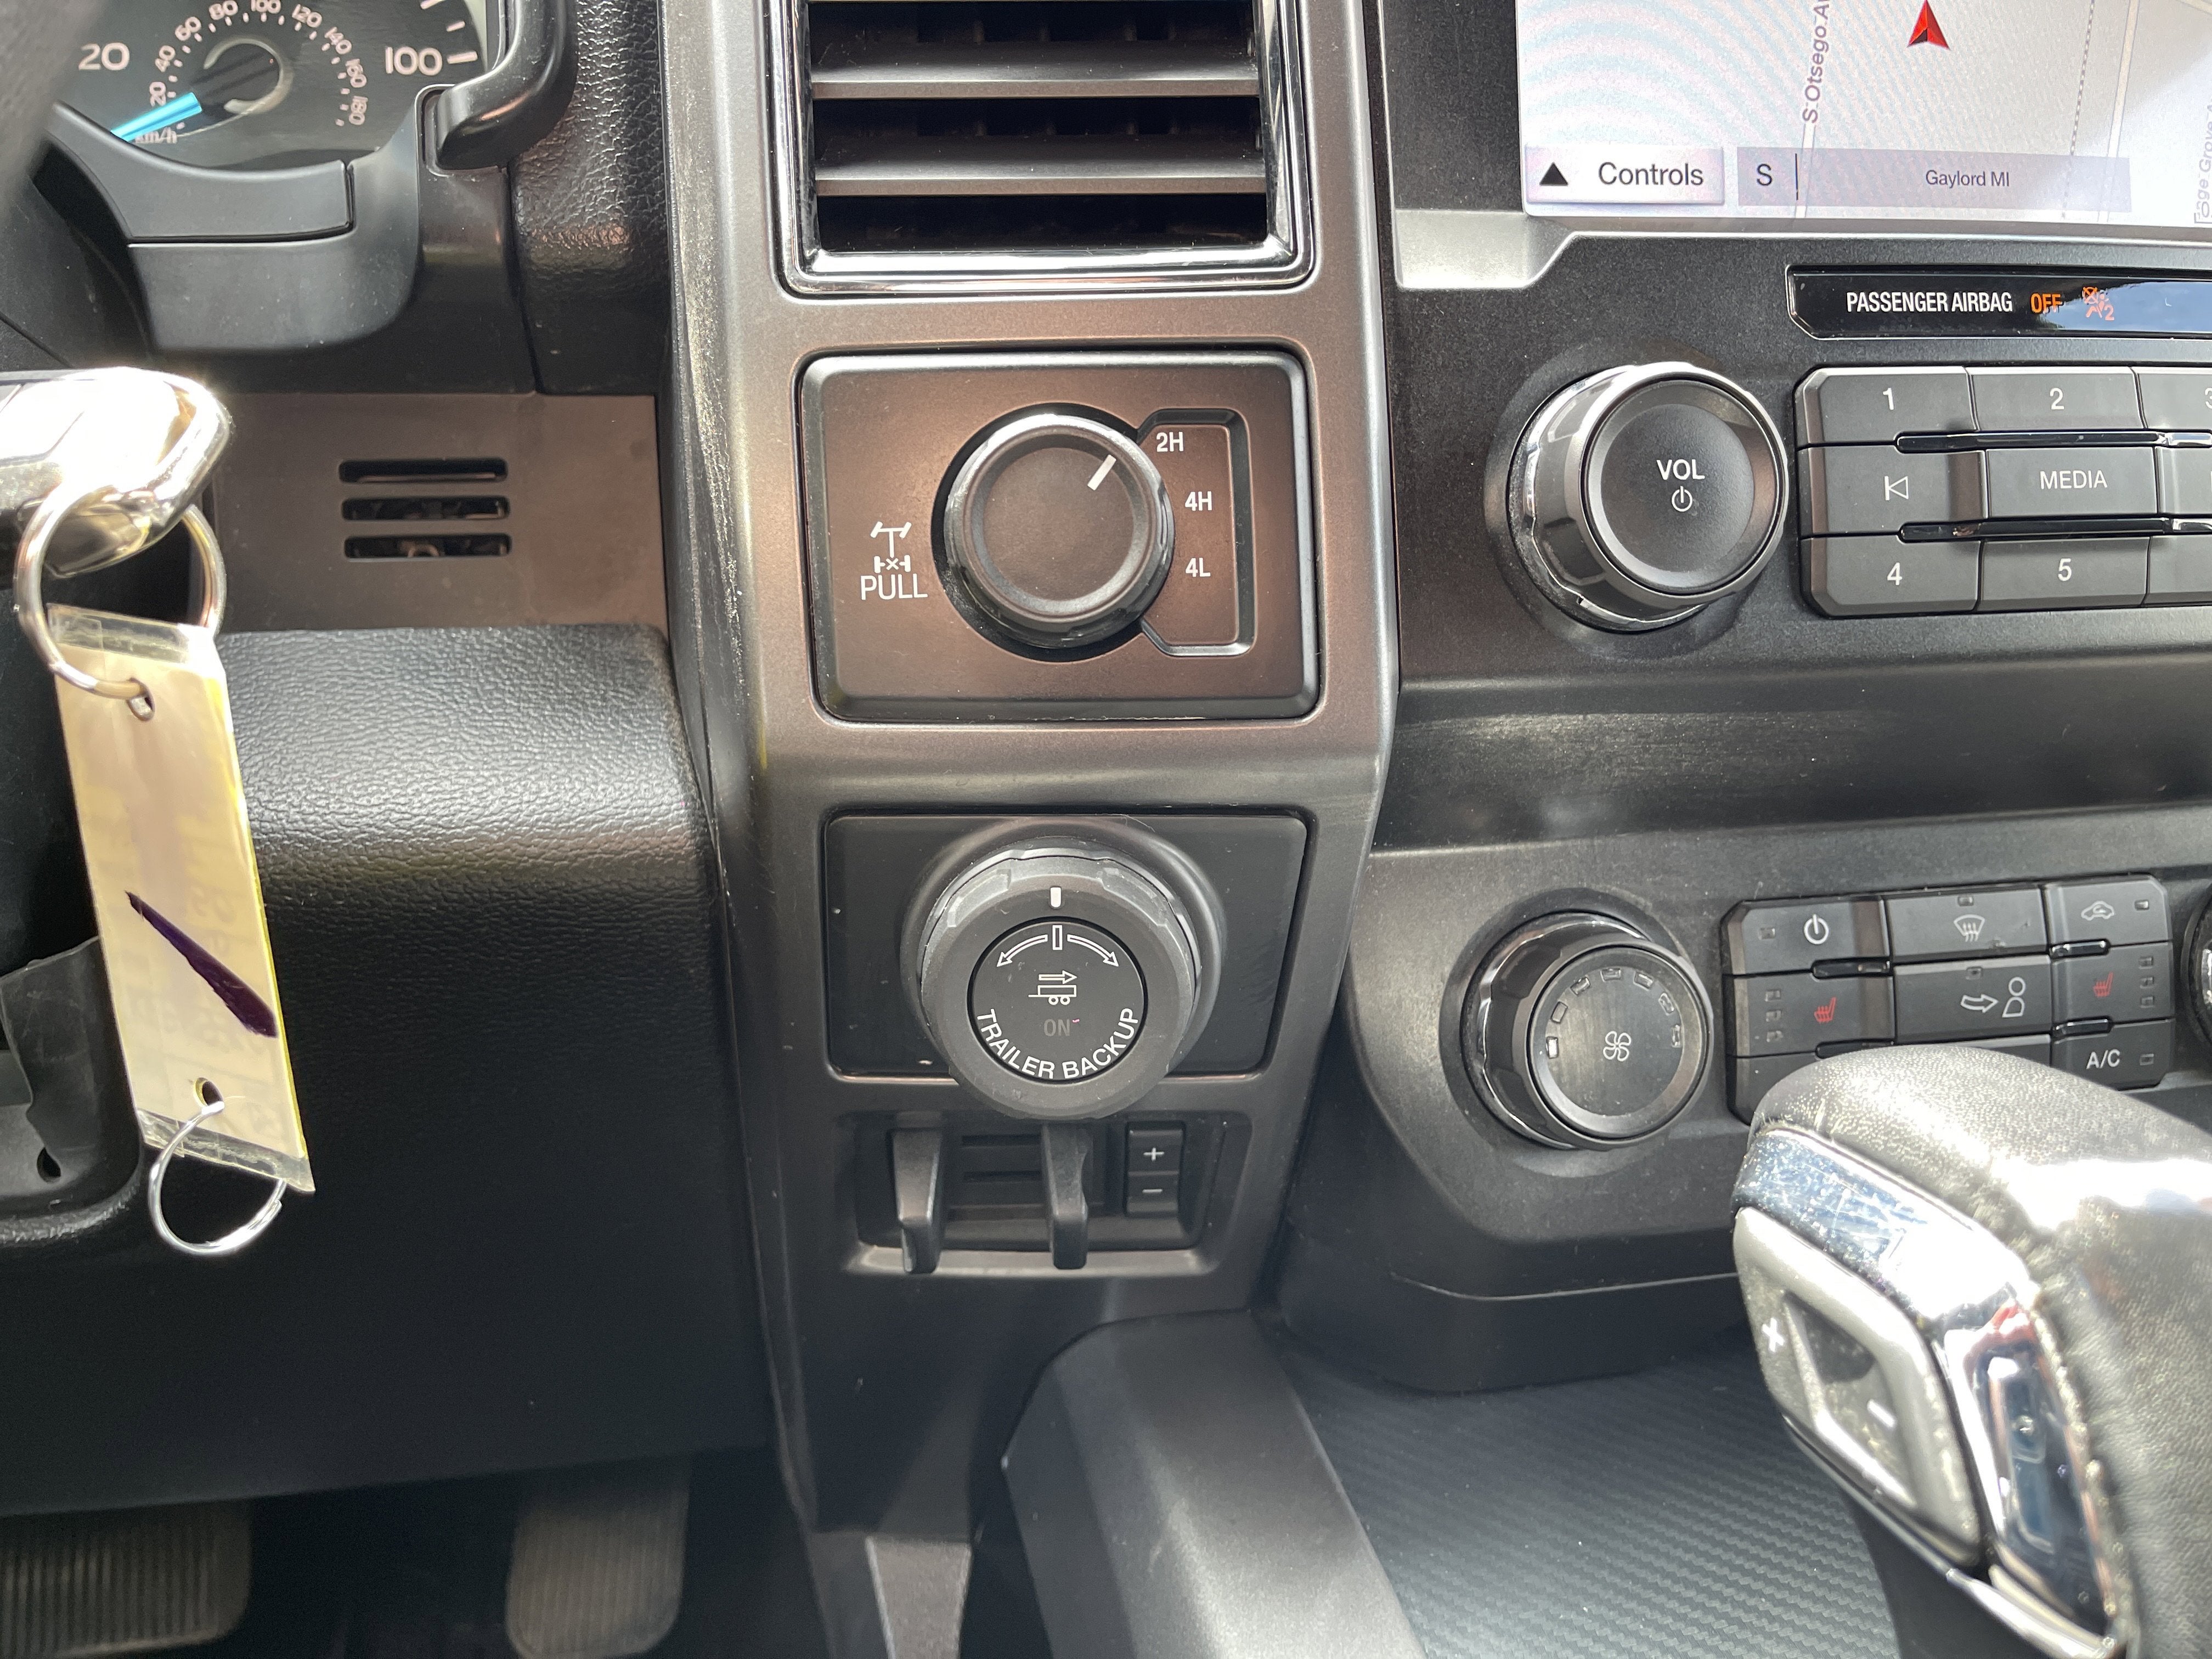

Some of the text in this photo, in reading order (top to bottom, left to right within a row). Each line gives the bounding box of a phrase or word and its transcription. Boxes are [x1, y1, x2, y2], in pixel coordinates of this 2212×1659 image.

[208, 0, 238, 20] 80
[250, 0, 281, 14] 100
[292, 3, 323, 27] 120
[174, 16, 202, 41] 60
[324, 27, 352, 54] 140
[78, 42, 130, 71] 20
[155, 45, 176, 72] 40
[385, 46, 443, 76] 100
[1802, 0, 1829, 123] S Otsego A
[345, 59, 367, 88] 160
[149, 81, 166, 107] 20
[348, 95, 368, 125] 180
[1598, 162, 1704, 185] Controls
[1756, 163, 1773, 186] S
[1926, 170, 2010, 189] Gaylord MI
[1847, 291, 2062, 313] PASSENGER AIRBAG OFF
[1882, 387, 1894, 410] 1
[2050, 387, 2064, 410] 2
[1156, 431, 1184, 453] 2H
[1656, 459, 1706, 481] VOL
[2040, 470, 2108, 489] MEDIA
[1184, 491, 1212, 511] 4H
[1185, 557, 1211, 577] 4L
[1887, 562, 1903, 586] 4
[2058, 558, 2072, 582] 5
[860, 574, 928, 600] PULL
[1043, 1019, 1070, 1037] ON
[977, 1007, 1139, 1079] TRAILER BACKUP
[2086, 1049, 2121, 1069] A/C
